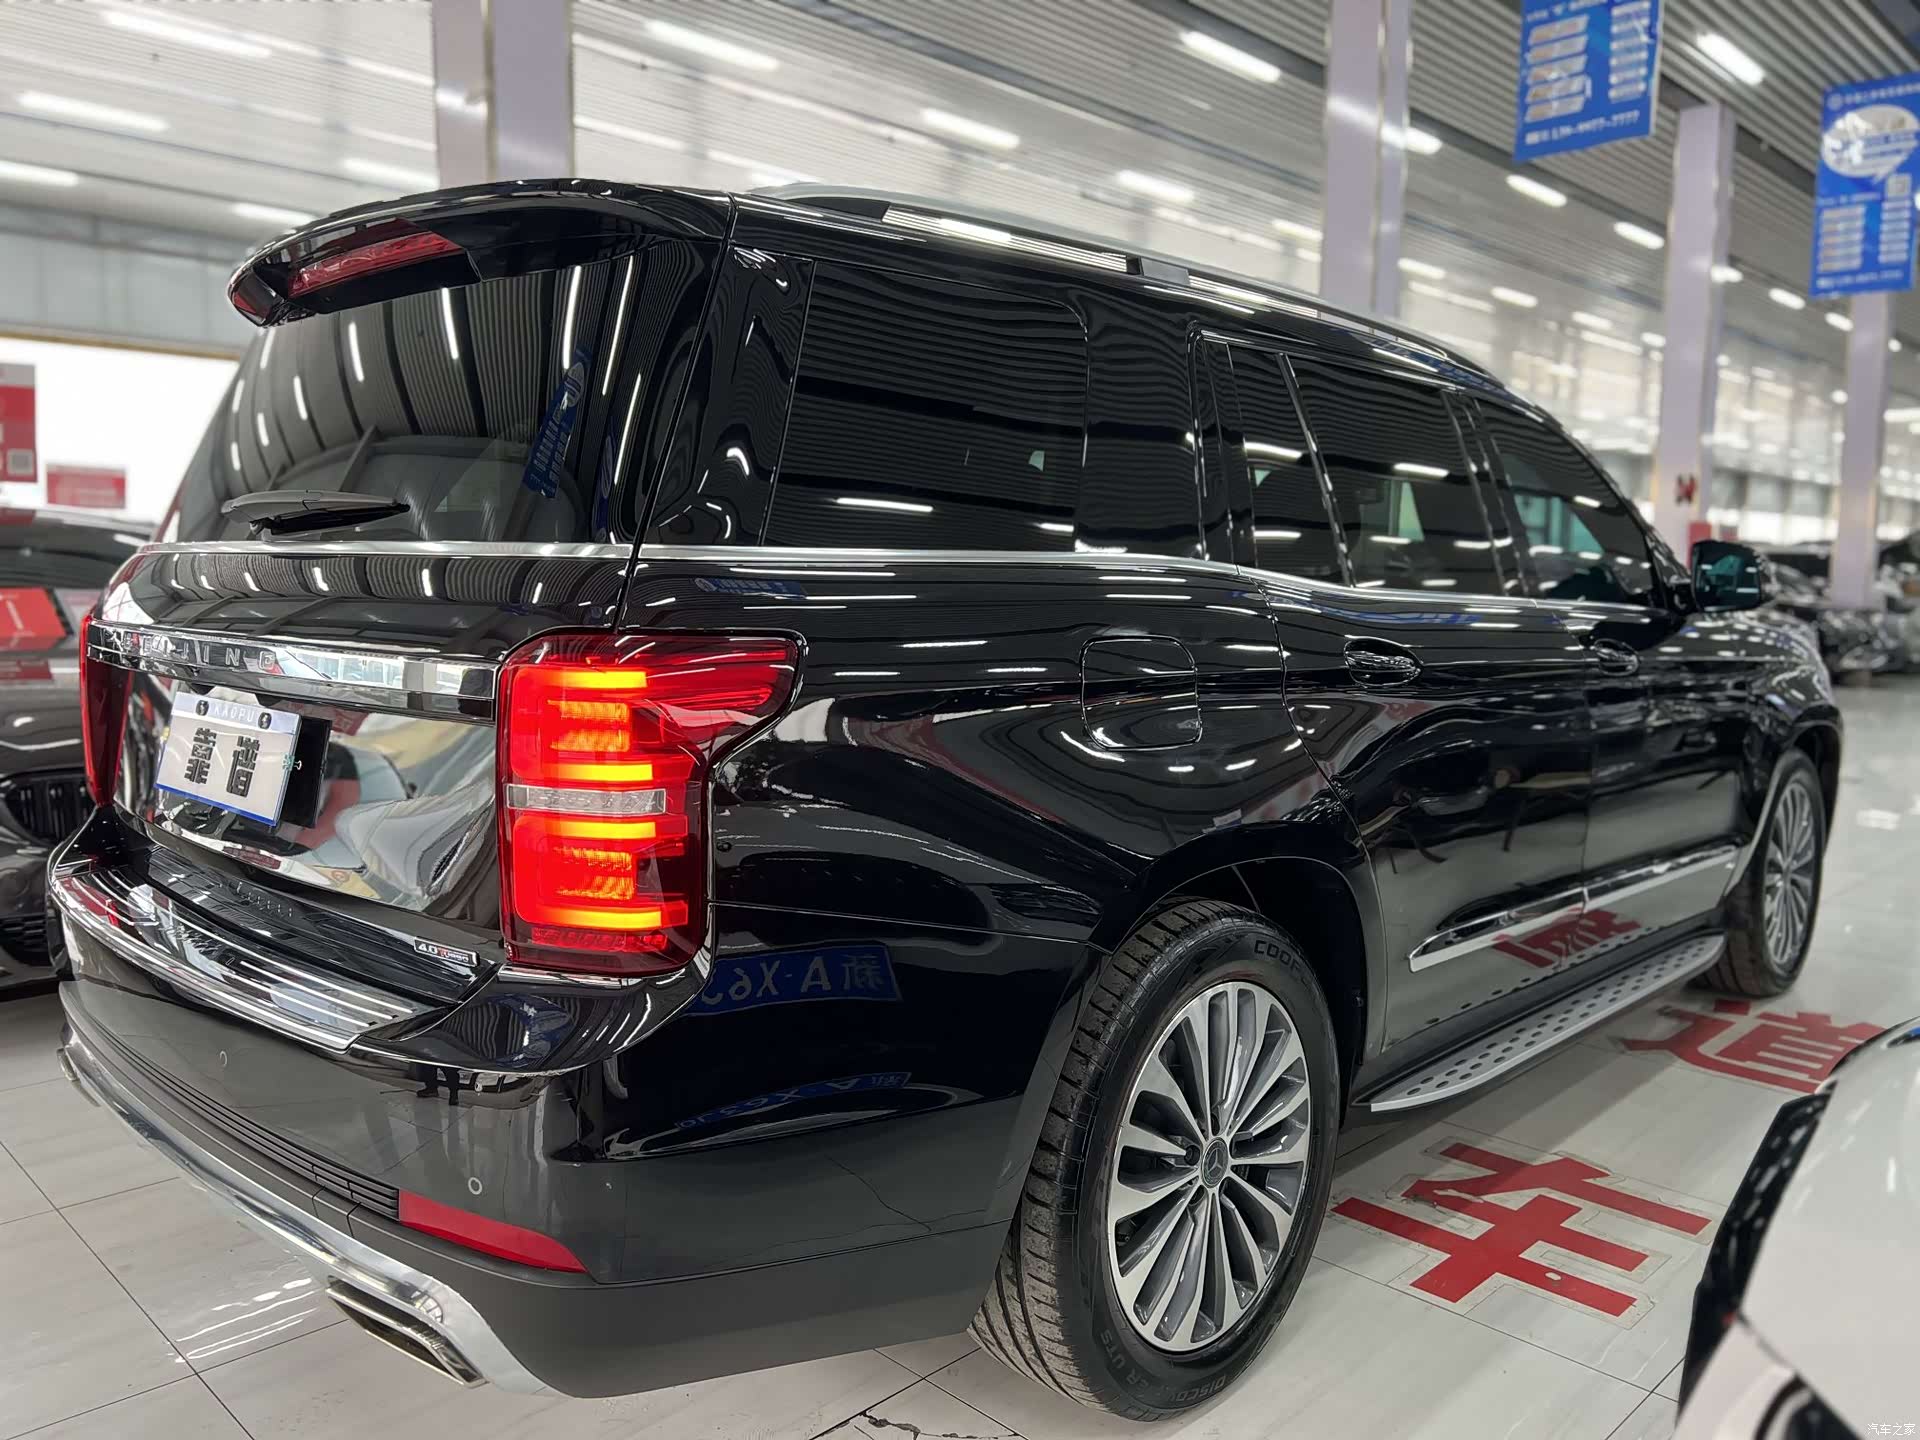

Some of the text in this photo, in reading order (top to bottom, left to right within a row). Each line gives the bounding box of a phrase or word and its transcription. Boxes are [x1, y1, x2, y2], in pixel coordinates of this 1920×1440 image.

[213, 703, 256, 723] KAOPU
[184, 727, 260, 798] 靠谱
[1331, 1142, 1712, 1317] 车
